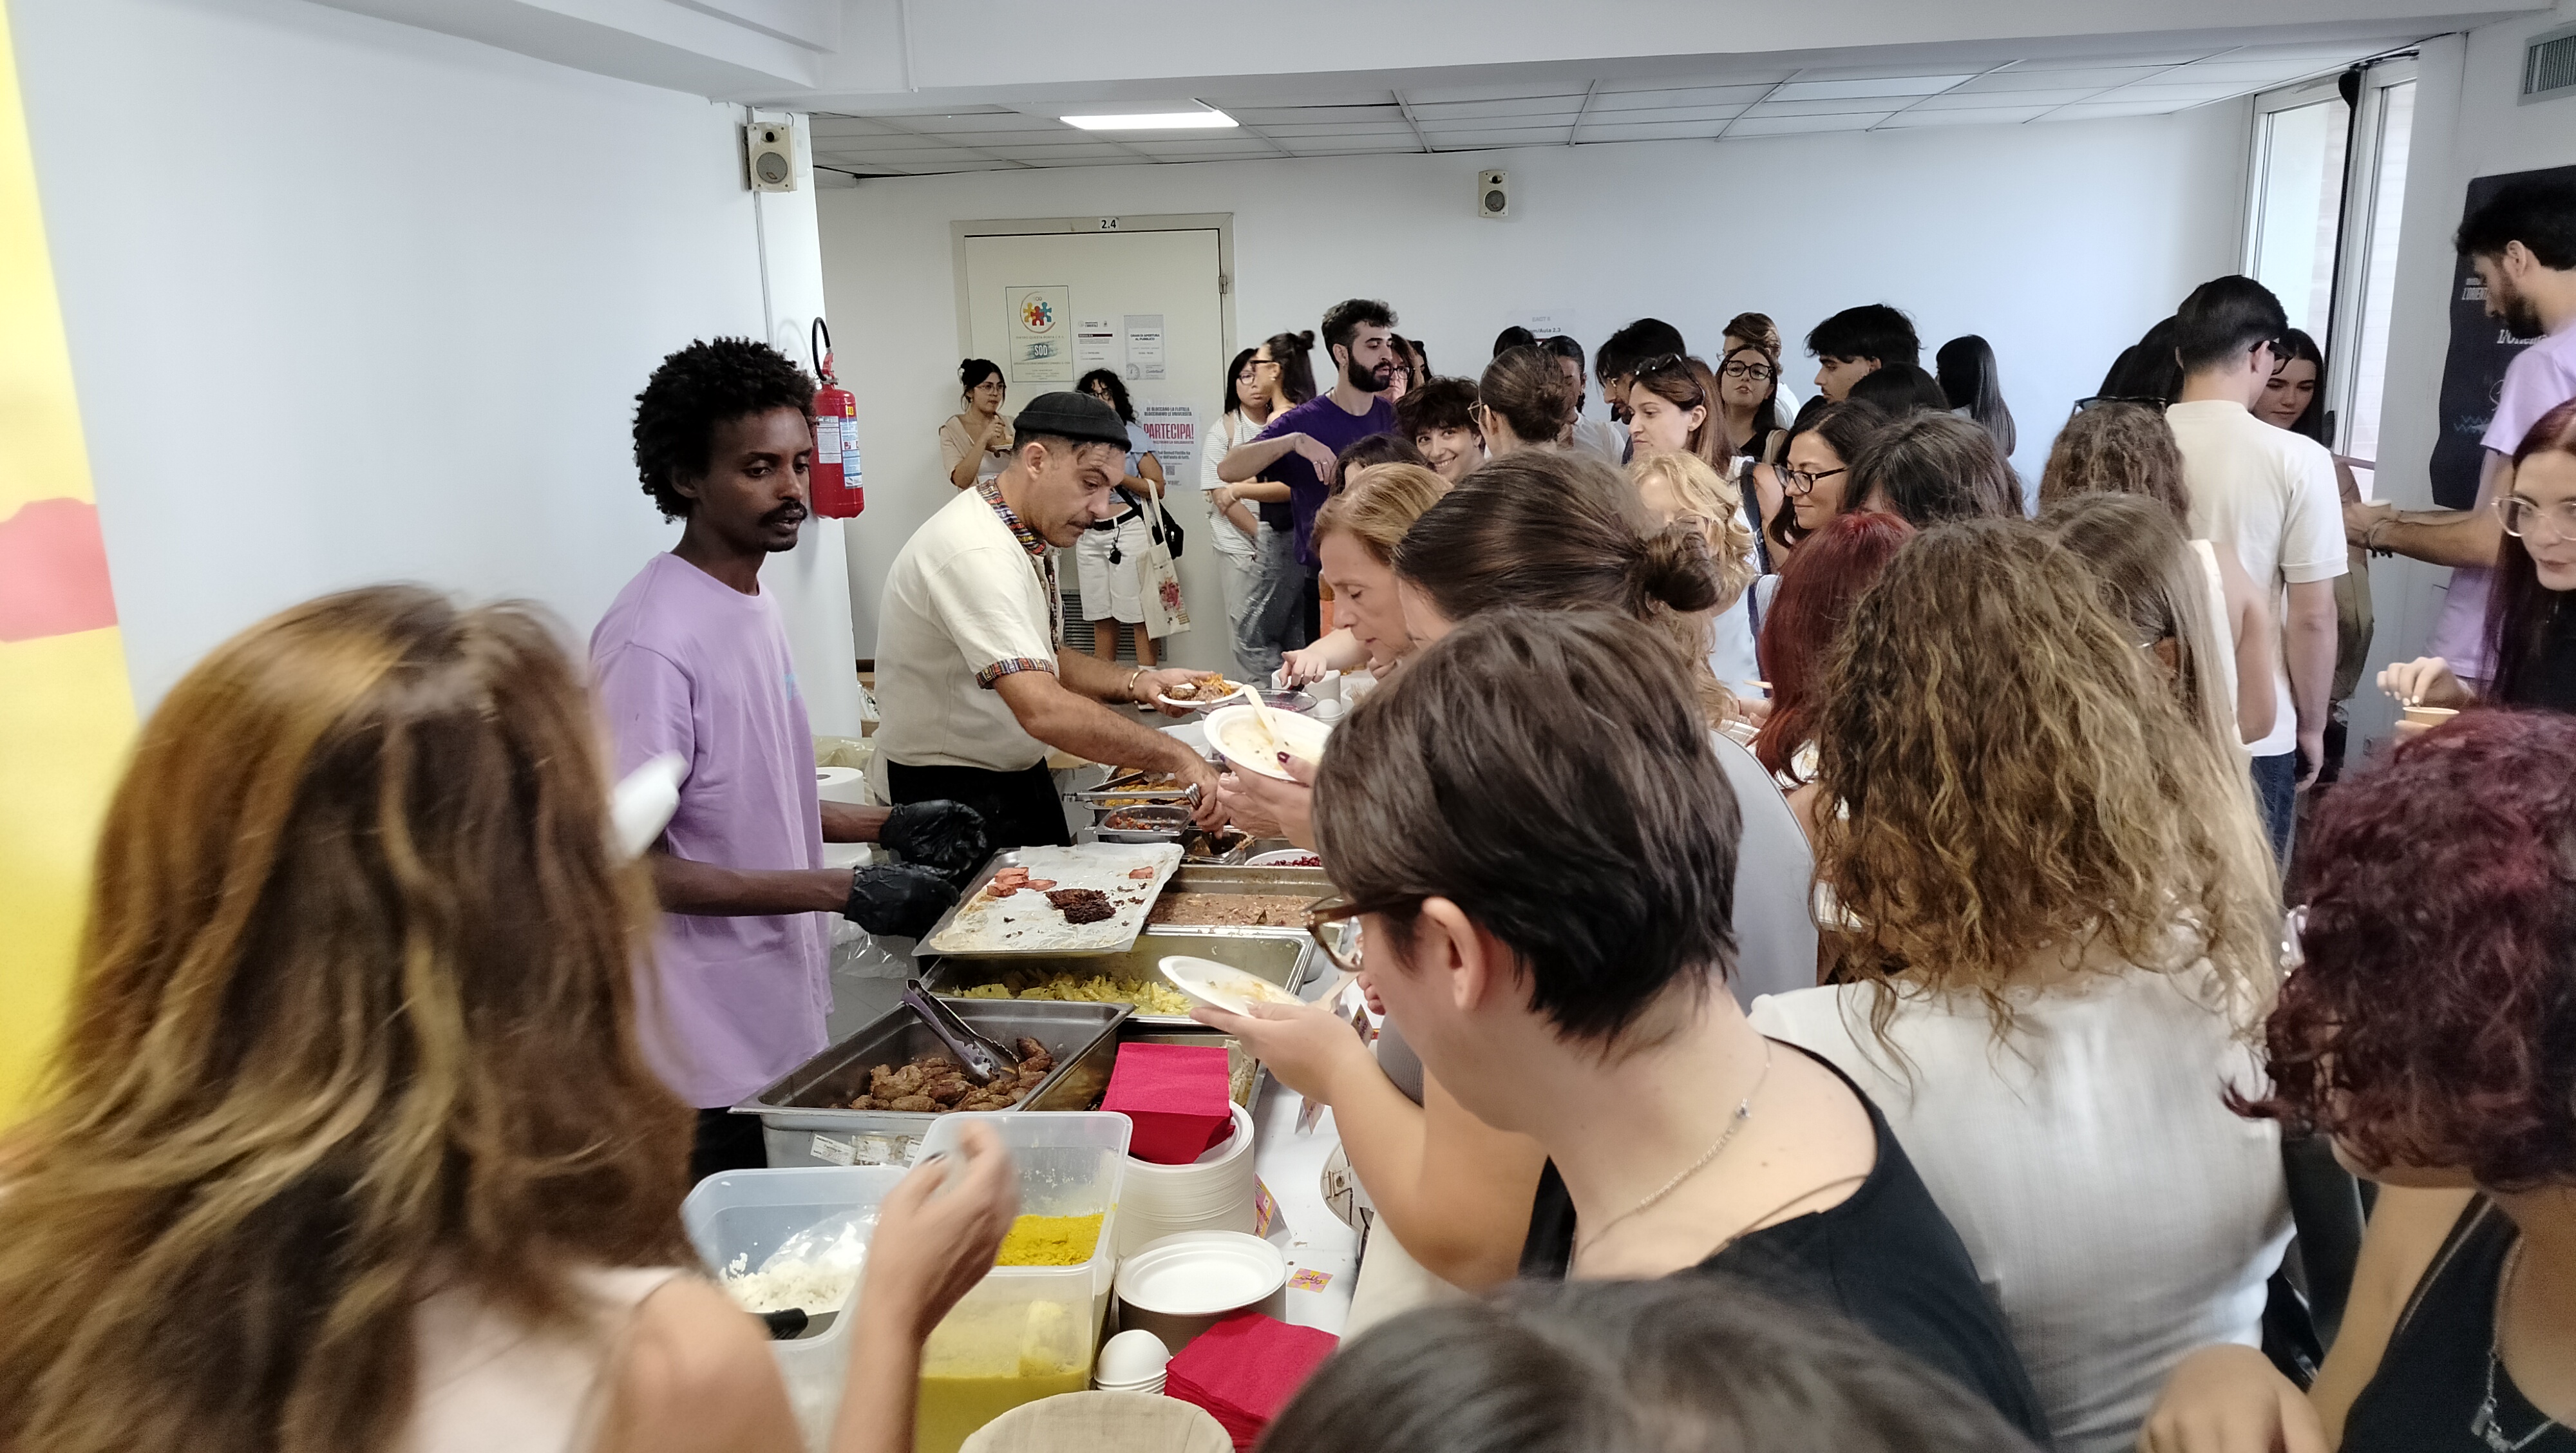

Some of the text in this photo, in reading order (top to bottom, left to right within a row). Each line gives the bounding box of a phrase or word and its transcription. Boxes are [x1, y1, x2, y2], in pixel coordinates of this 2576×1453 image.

[1101, 220, 1117, 229] 2.4
[1034, 345, 1048, 356] SOD
[1143, 423, 1194, 440] PARTECIPA!
